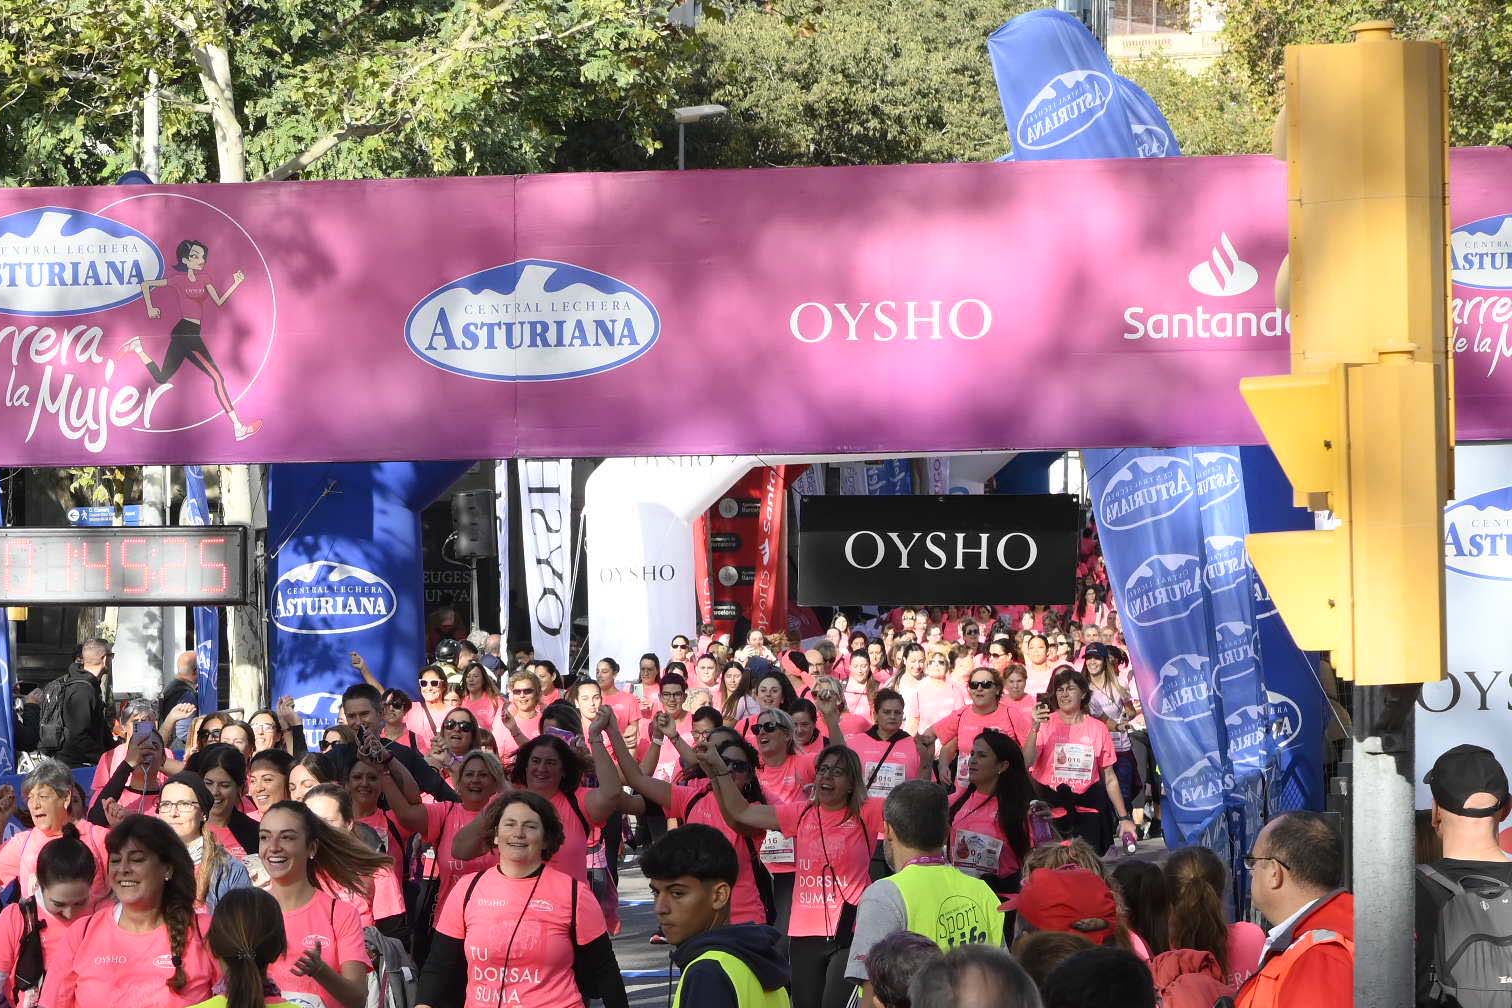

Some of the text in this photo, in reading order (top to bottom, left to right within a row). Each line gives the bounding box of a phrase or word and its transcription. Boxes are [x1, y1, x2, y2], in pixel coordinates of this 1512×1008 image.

[67, 242, 140, 255] LECHERA
[463, 299, 632, 315] CENTRAL LECHERA
[424, 306, 640, 352] ASTURIANA
[788, 298, 993, 344] OYSHO
[5, 368, 30, 407] la
[25, 357, 174, 454] Mujer
[844, 530, 1038, 571] OYSHO
[286, 585, 384, 595] CENTRAL LECHERA
[275, 590, 388, 619] ASTURIANA
[799, 876, 849, 888] DORSAL
[938, 903, 980, 939] Sport
[947, 925, 988, 949] Life
[469, 945, 488, 962] TU
[474, 967, 541, 984] DORSAL
[475, 985, 521, 1004] SUMA
